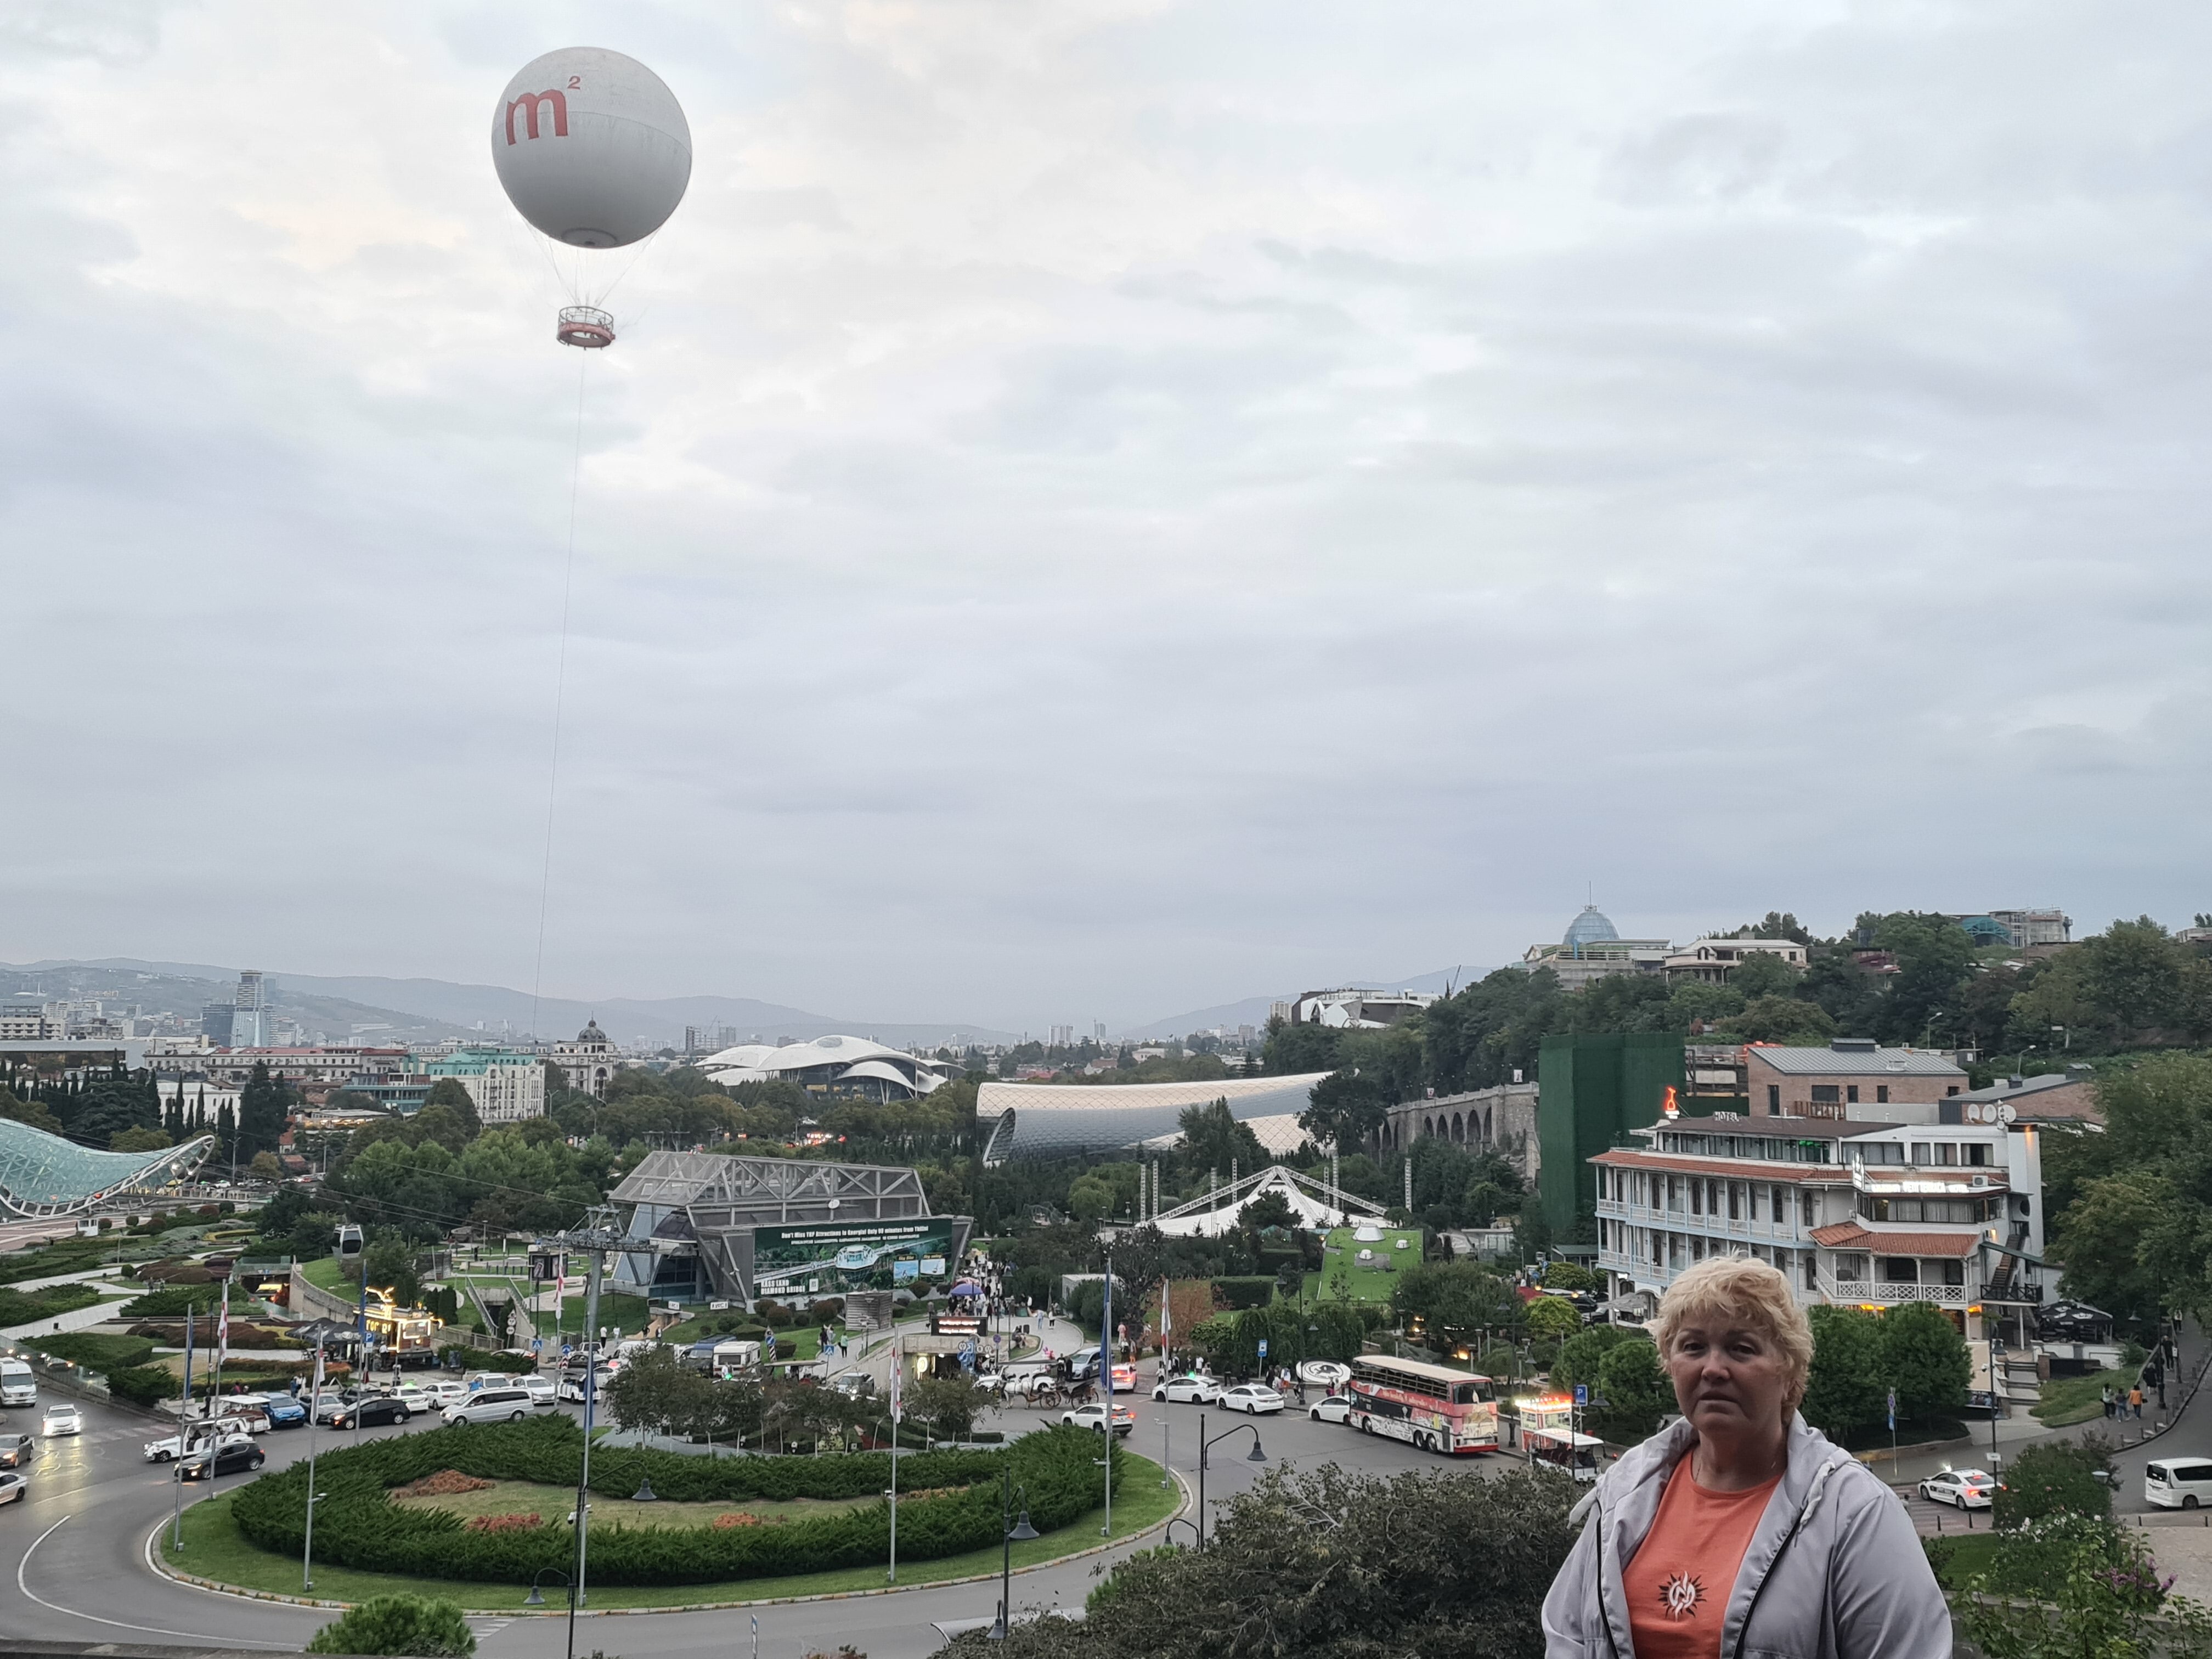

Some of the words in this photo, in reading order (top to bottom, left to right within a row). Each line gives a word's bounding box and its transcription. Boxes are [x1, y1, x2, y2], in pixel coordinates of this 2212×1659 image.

[1714, 1111, 1739, 1122] HOTEL
[786, 1285, 805, 1293] BRIDGE
[366, 1333, 372, 1341] P
